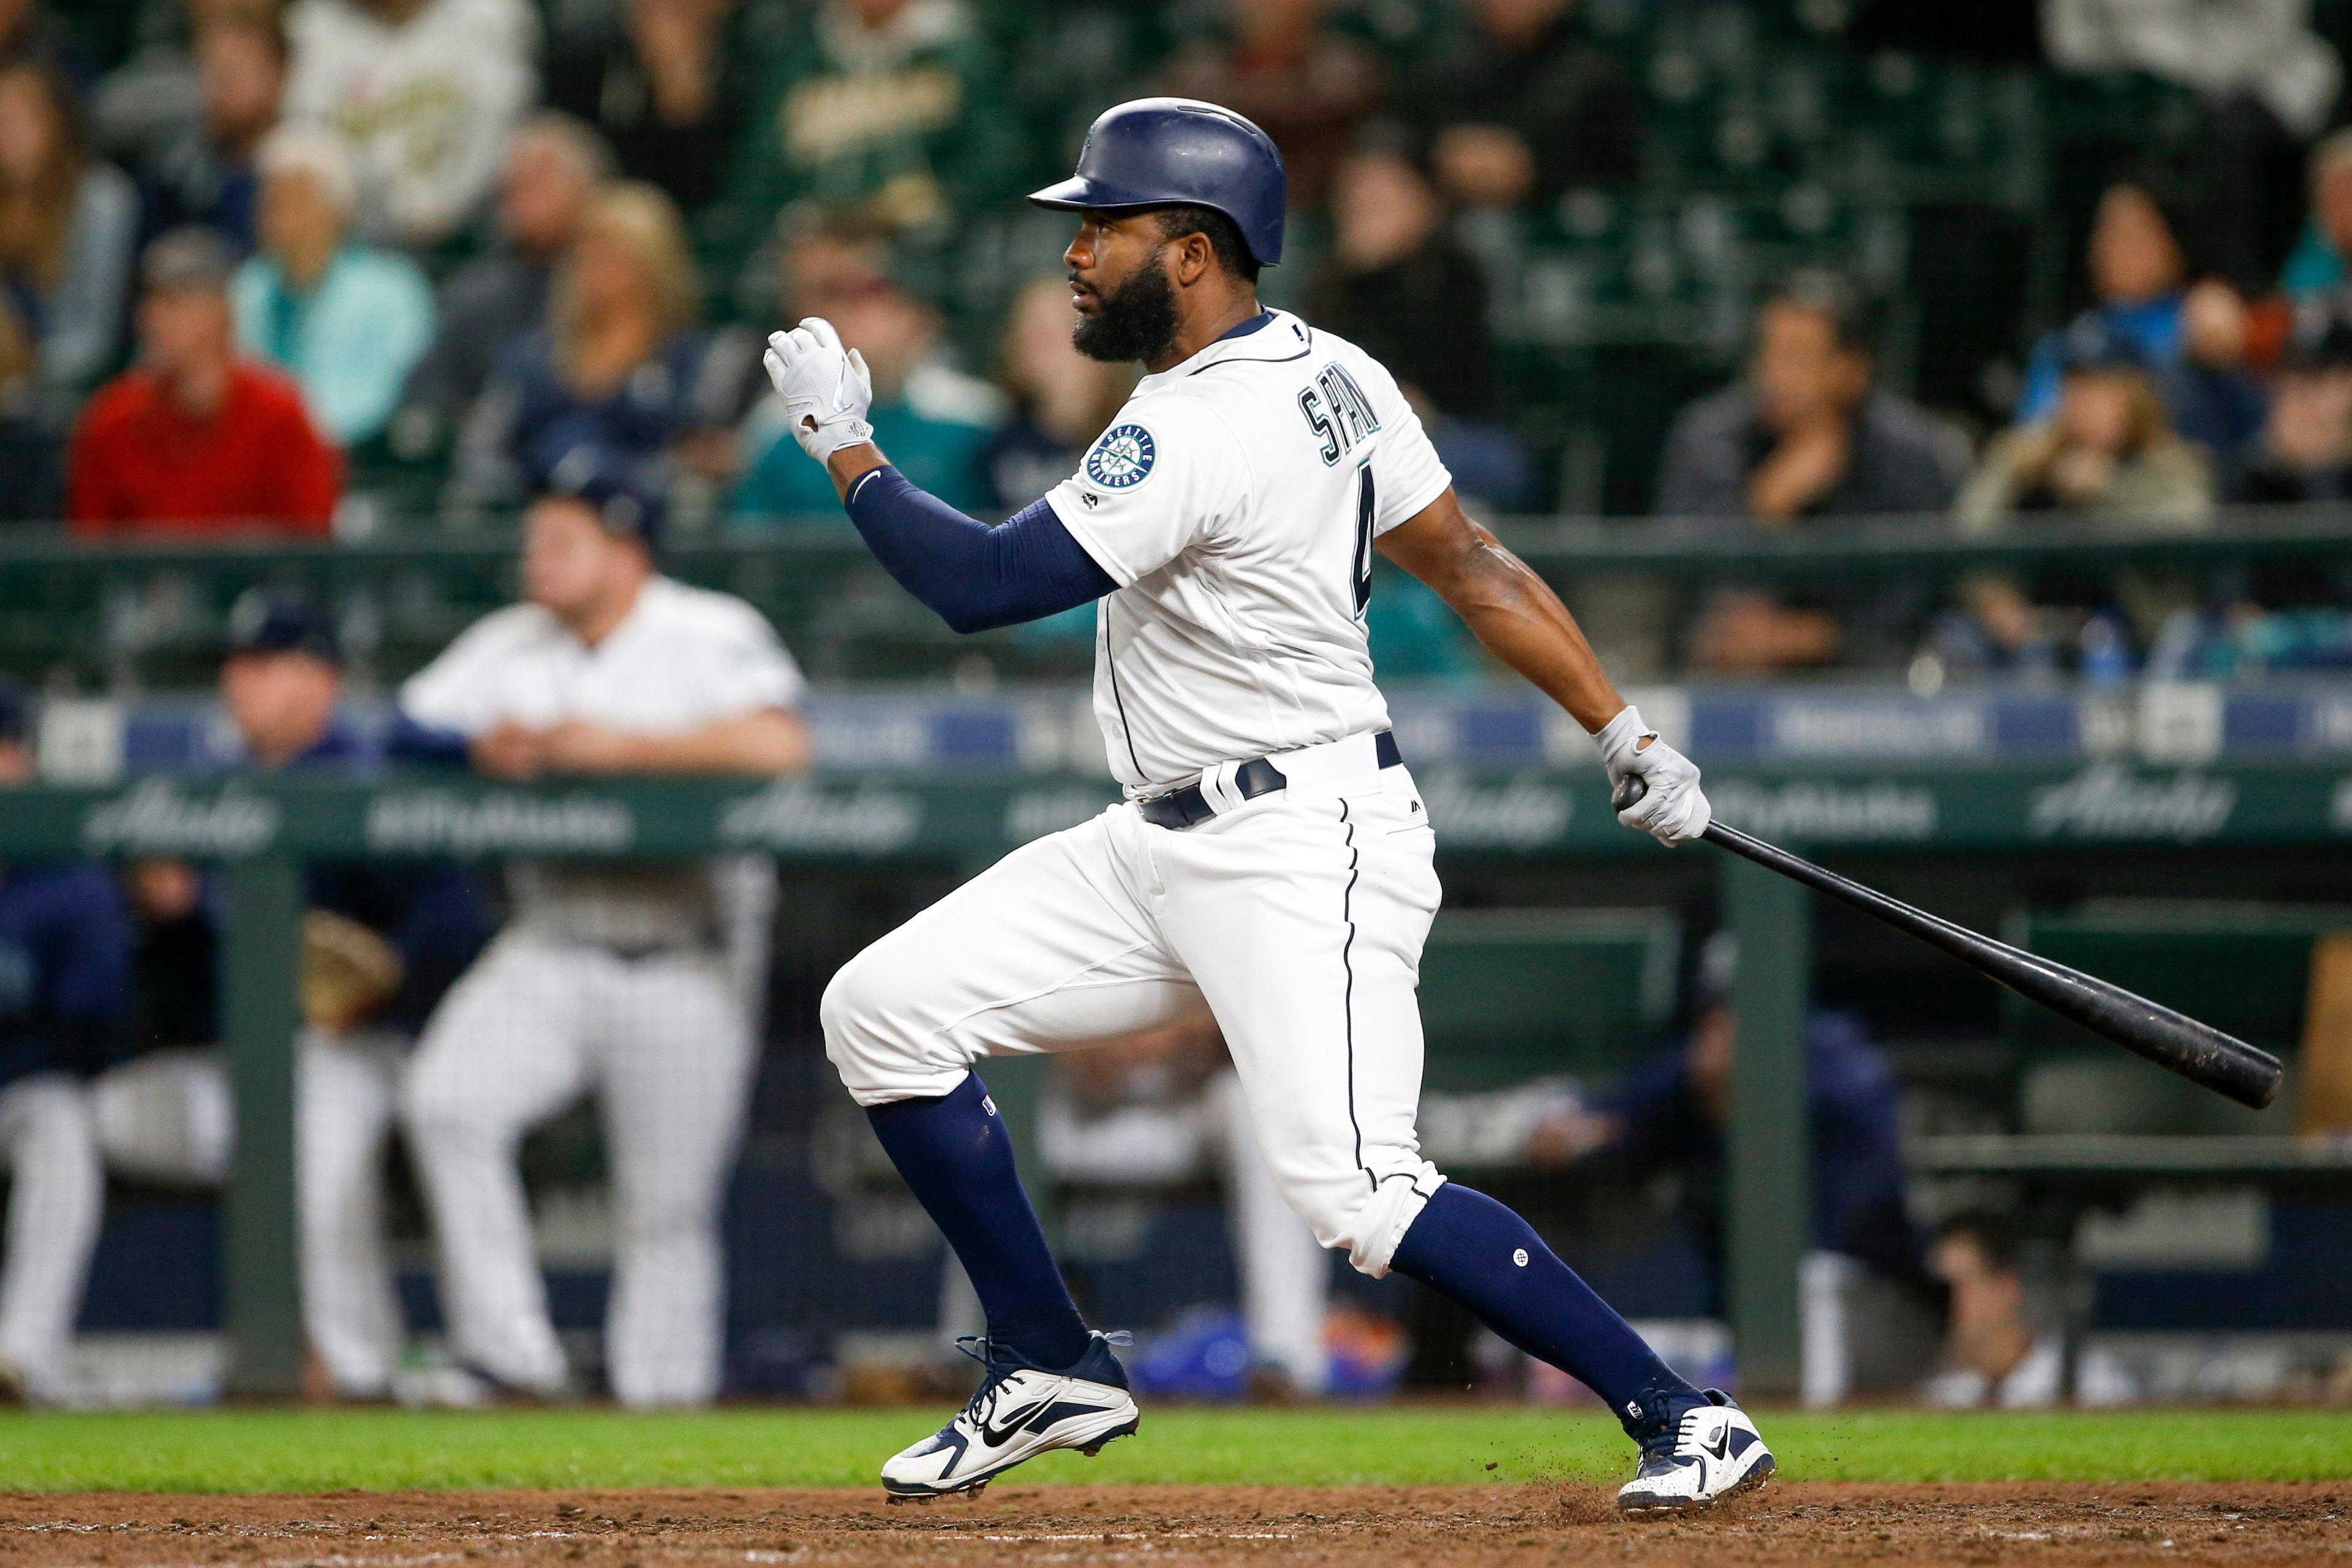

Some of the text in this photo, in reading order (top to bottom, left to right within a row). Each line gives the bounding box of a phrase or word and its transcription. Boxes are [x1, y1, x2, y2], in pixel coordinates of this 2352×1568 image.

[1107, 426, 1152, 461] SEATTLE
[1297, 360, 1382, 467] SPAN
[1089, 454, 1140, 486] MARINERS
[1349, 456, 1375, 621] 4
